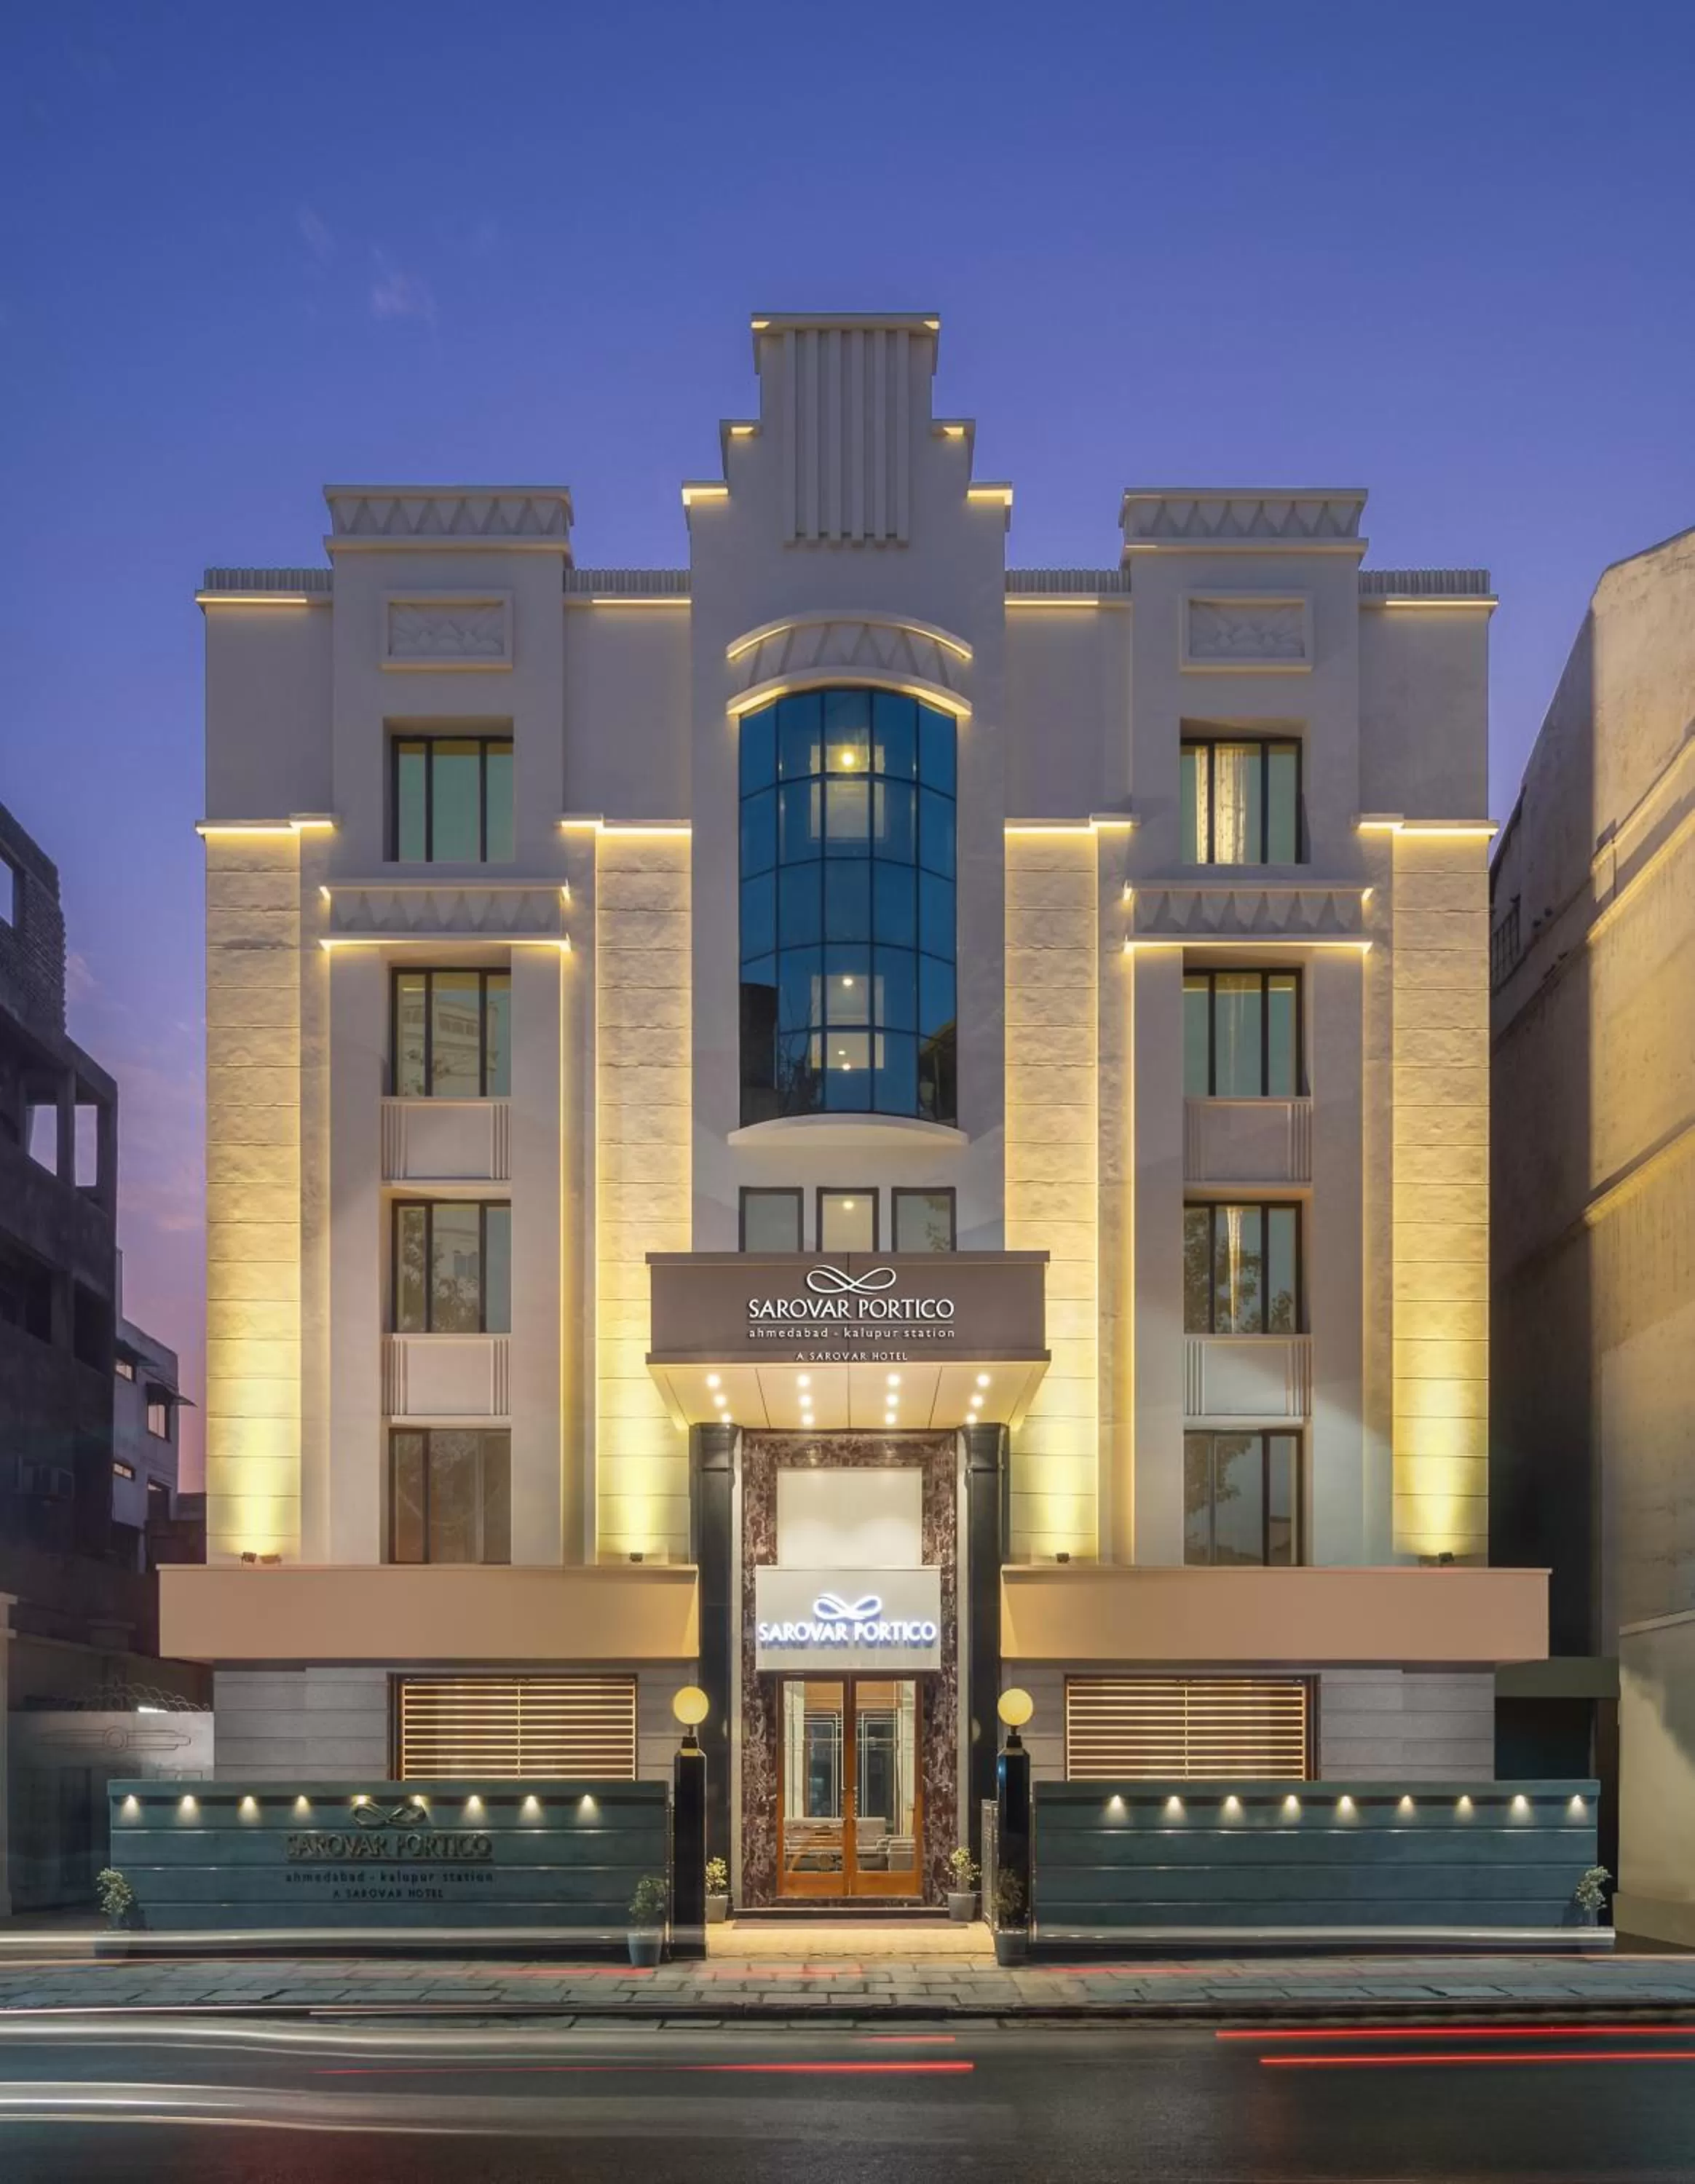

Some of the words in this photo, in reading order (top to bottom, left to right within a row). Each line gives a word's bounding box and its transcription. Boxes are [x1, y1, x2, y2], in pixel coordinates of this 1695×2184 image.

[748, 1299, 851, 1318] SAROVAR
[858, 1299, 954, 1318] PORTICO
[749, 1326, 829, 1338] ahmedabad
[844, 1326, 898, 1340] kalupur
[904, 1326, 955, 1338] station
[796, 1352, 805, 1361] A
[809, 1352, 867, 1361] SAROVAR
[872, 1352, 908, 1361] HOTEL
[759, 1622, 848, 1642] SAROVAR
[854, 1622, 937, 1641] PORTICO
[288, 1834, 387, 1857] SAROVAR
[398, 1834, 493, 1857] PORTICO
[285, 1871, 364, 1883] ahmedabad
[380, 1871, 434, 1885] kalupur
[443, 1871, 493, 1883] station
[333, 1889, 340, 1899] A
[347, 1889, 402, 1899] SAROVAR
[408, 1889, 443, 1899] HOTEL
